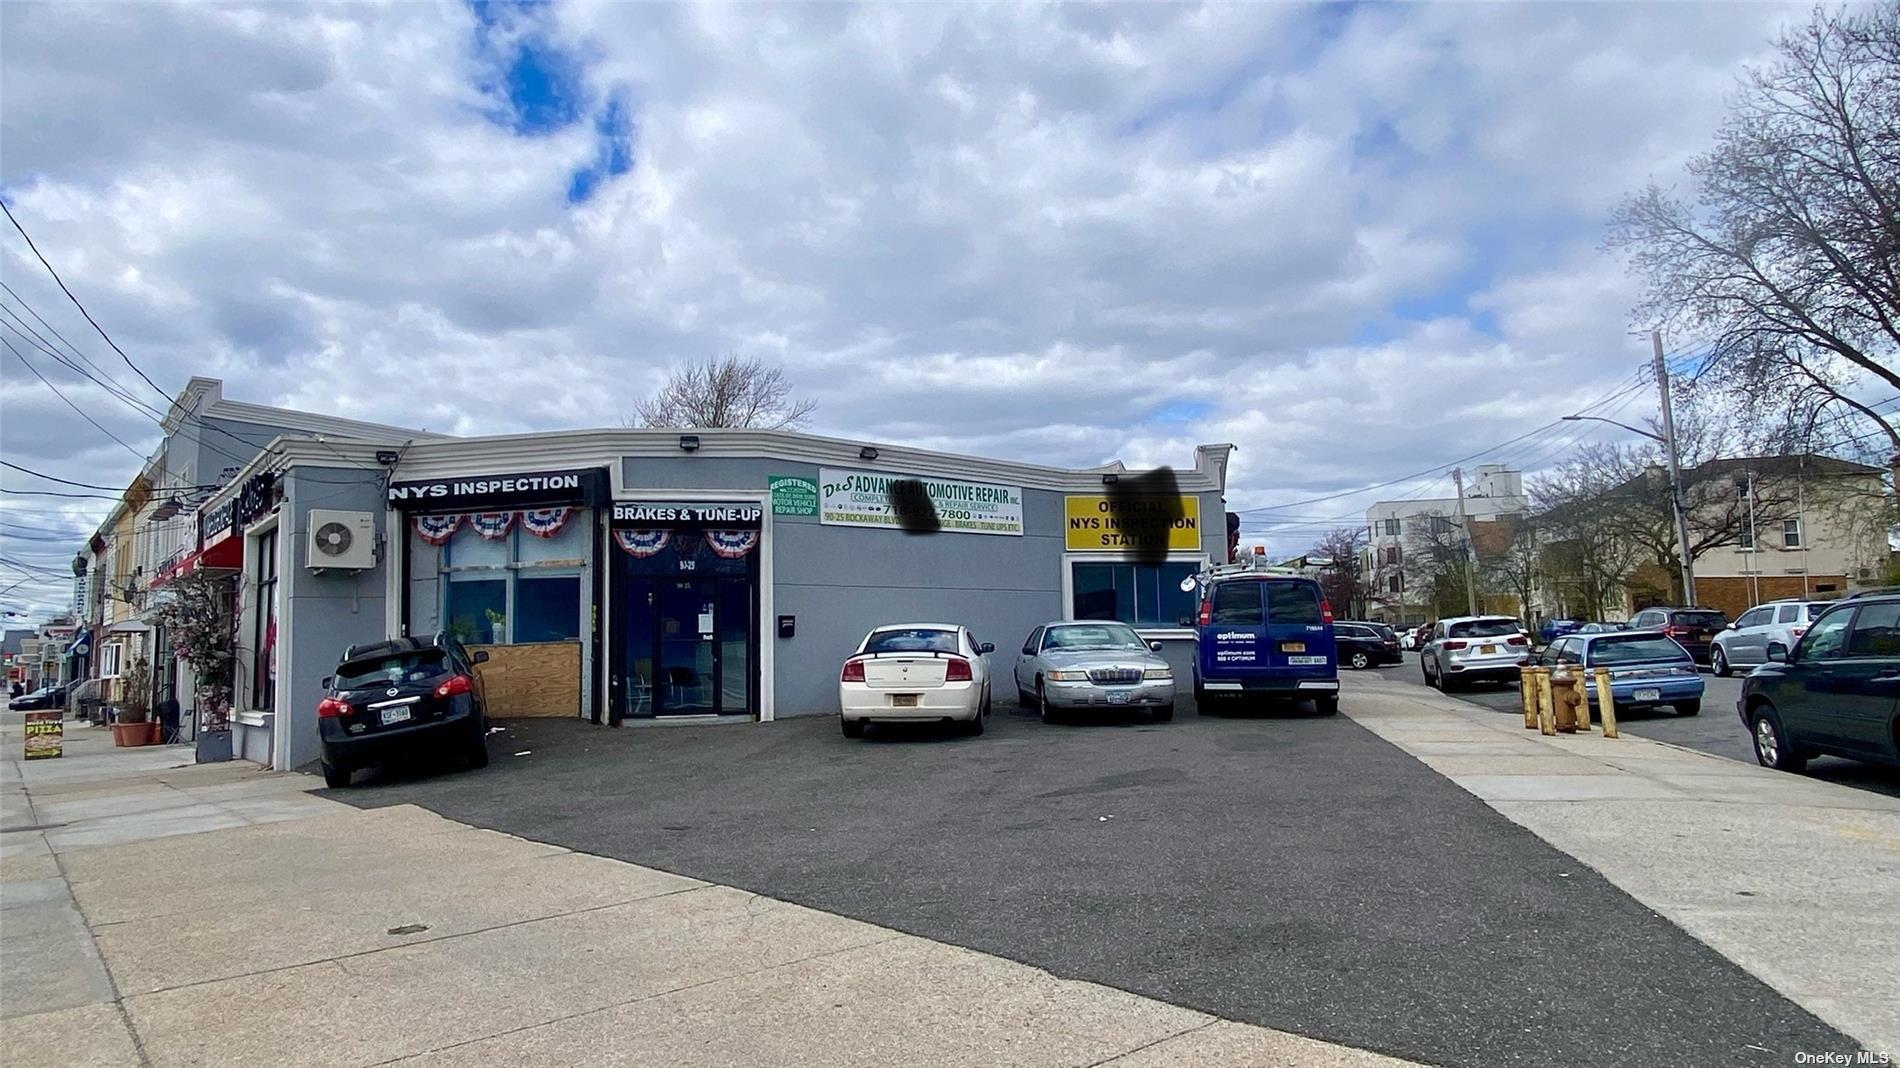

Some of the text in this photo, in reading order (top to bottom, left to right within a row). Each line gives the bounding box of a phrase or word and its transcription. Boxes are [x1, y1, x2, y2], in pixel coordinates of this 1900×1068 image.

[389, 475, 578, 500] NYS INSPECTION
[770, 478, 817, 493] REGISTERED
[823, 475, 854, 498] D&S
[976, 487, 1009, 504] REPAIR
[773, 498, 817, 508] MOTOR VEHICLE
[944, 501, 968, 509] REPAIR
[613, 507, 761, 521] BRAKES & TUNE-UP
[775, 505, 813, 514] REPAIR SHOP
[824, 512, 844, 522] 90-25
[845, 513, 883, 524] ROCKAWAY
[1070, 517, 1100, 529] NYS
[955, 521, 976, 529] BRAKES
[1217, 631, 1255, 641] optimum
[26, 725, 62, 735] PIZZA
